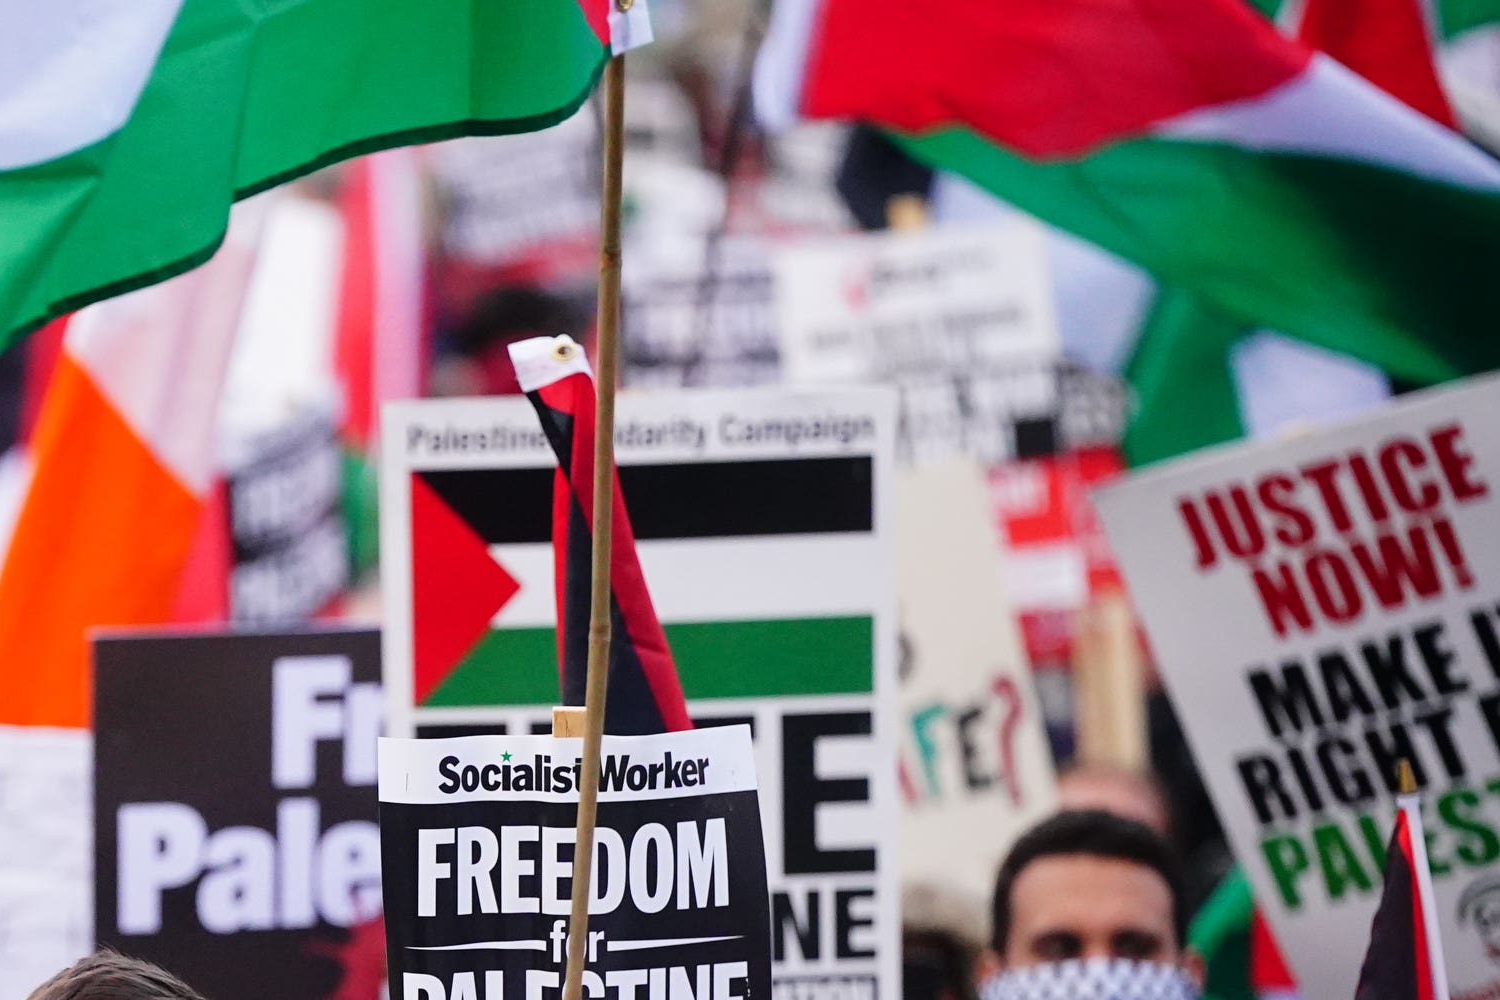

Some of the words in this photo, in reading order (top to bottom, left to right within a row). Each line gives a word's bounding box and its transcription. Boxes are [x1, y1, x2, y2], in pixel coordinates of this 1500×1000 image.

[718, 409, 875, 446] Campaign
[1177, 424, 1488, 570] JUSTICE
[1253, 517, 1474, 640] NOW!
[1246, 620, 1470, 738] MAKE
[438, 752, 582, 794] Socialist
[597, 751, 710, 792] Worker
[1234, 707, 1466, 825] RIGHT
[417, 817, 730, 917] FREEDOM
